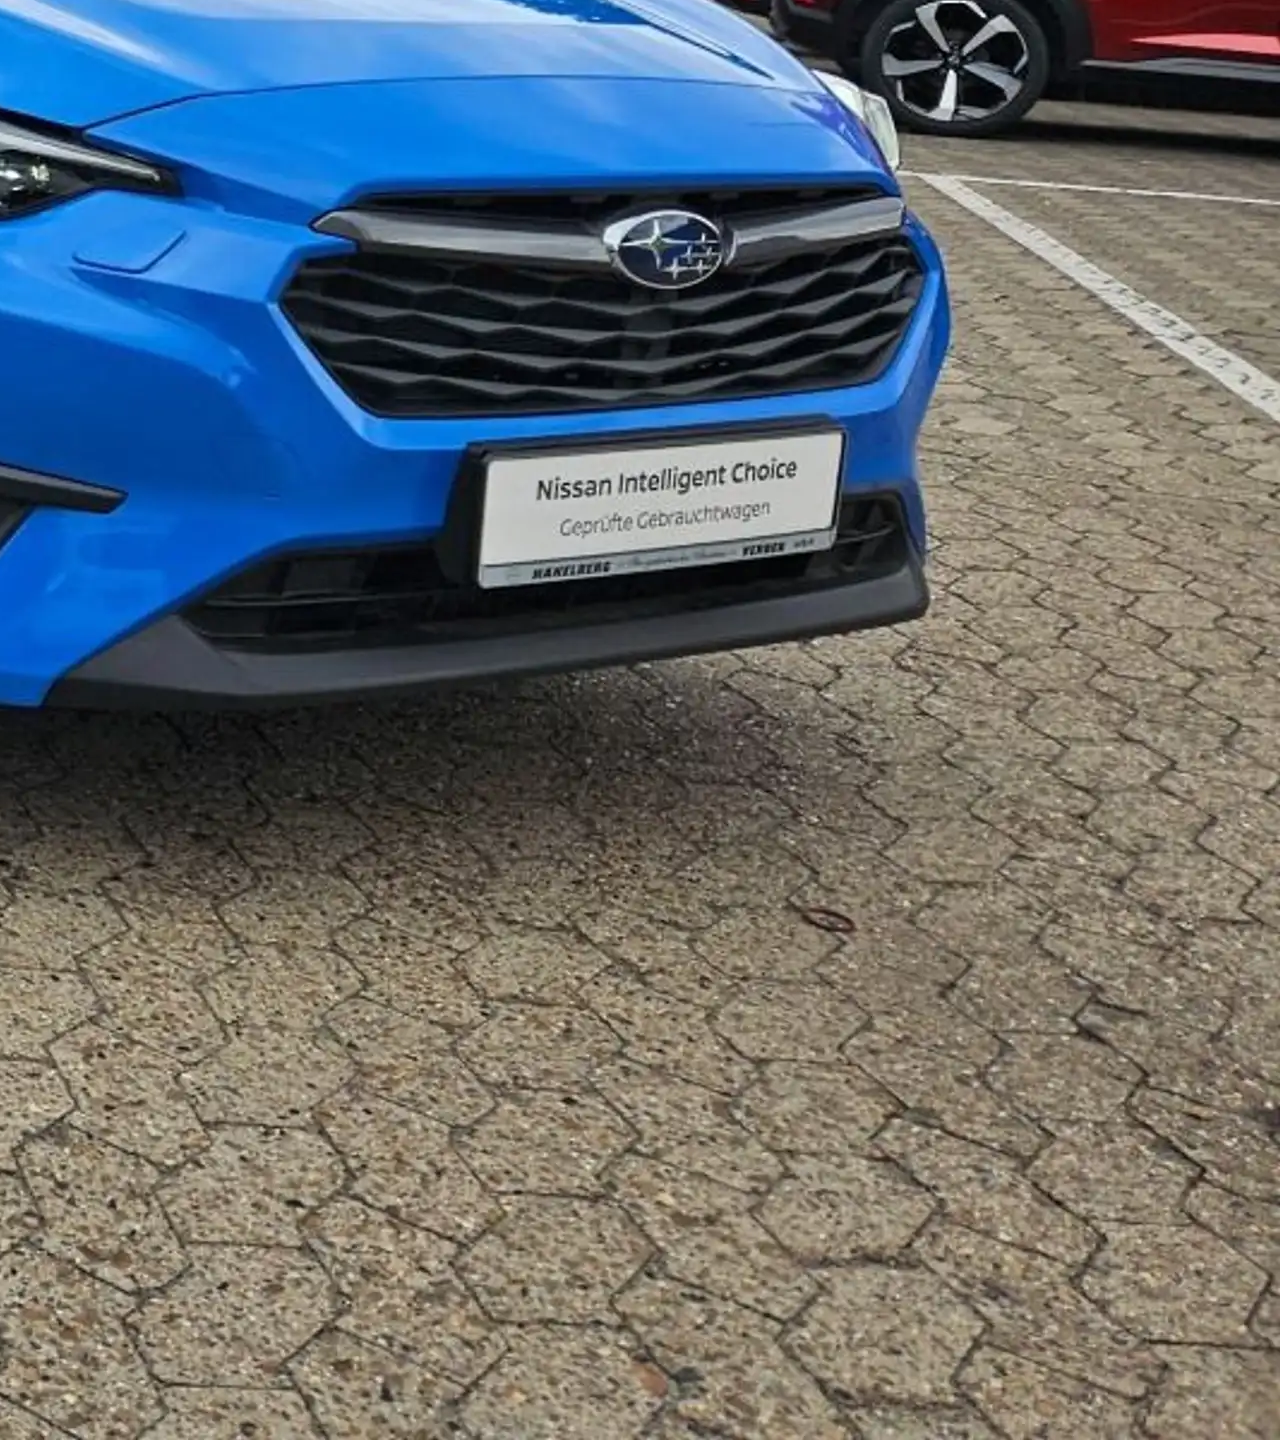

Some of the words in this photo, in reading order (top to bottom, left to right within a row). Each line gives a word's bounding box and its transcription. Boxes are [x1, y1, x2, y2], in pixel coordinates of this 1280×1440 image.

[536, 477, 613, 501] Nissan
[618, 462, 727, 496] Intelligent
[731, 458, 799, 484] Choice
[559, 510, 635, 538] Geprüfte
[636, 499, 772, 531] Gebrauchtwagen
[531, 561, 611, 580] HAKELBERG
